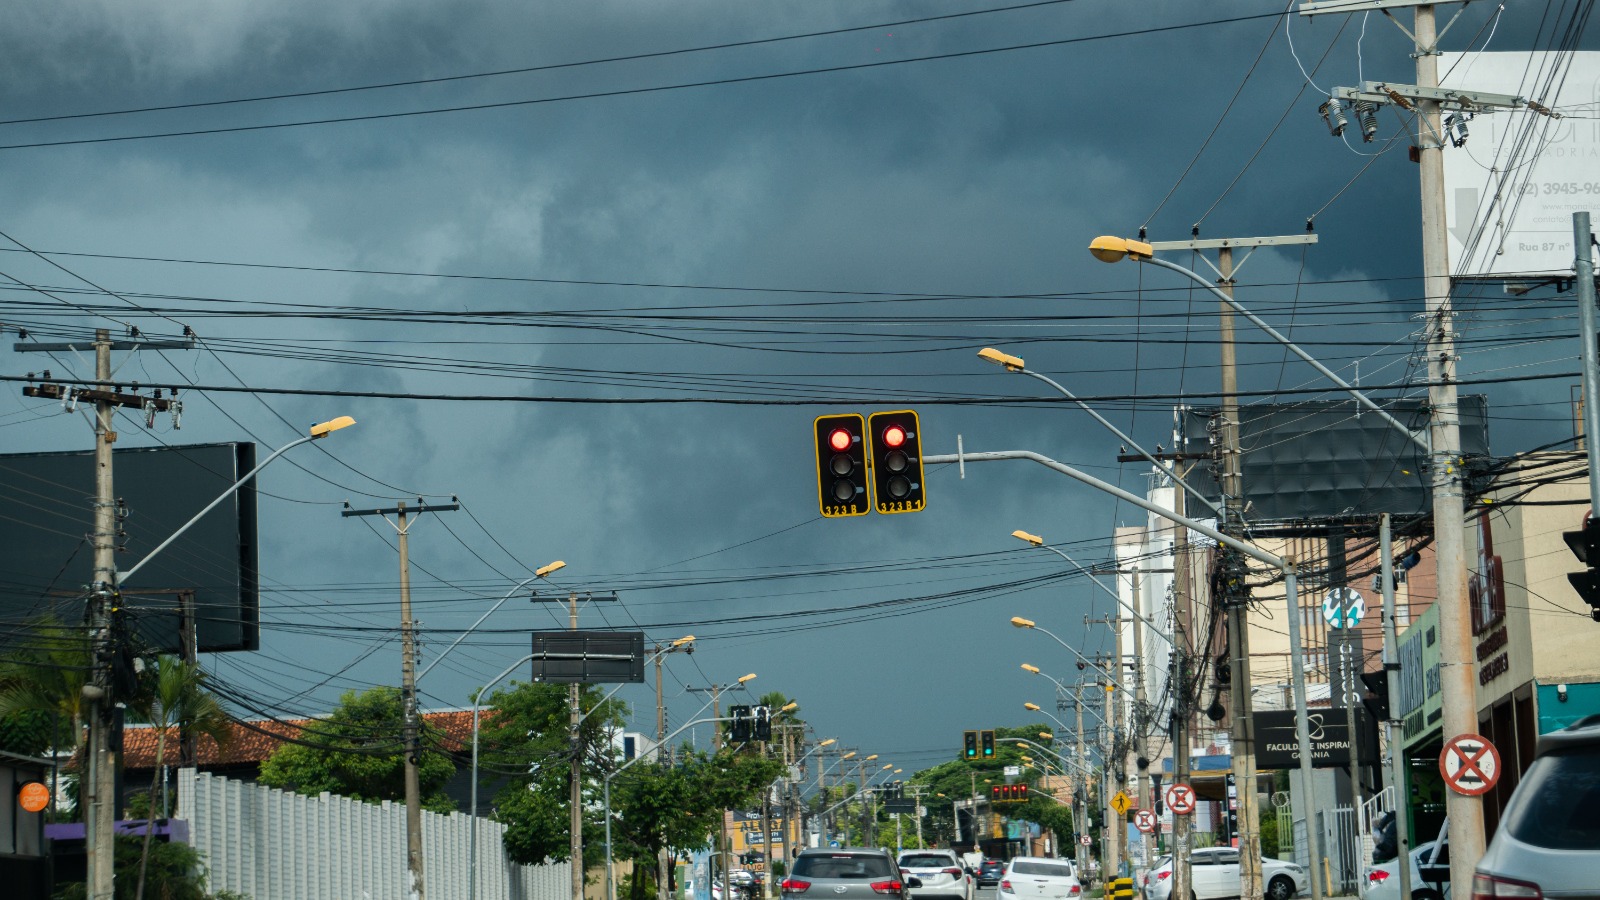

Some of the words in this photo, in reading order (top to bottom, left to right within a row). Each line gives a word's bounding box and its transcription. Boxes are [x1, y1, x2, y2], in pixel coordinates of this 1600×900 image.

[1512, 182, 1538, 197] (62)
[1543, 182, 1600, 194] 3945-96
[1519, 243, 1539, 251] Rua
[1542, 243, 1555, 251] 87
[1266, 743, 1314, 751] FACULDE
[1291, 751, 1330, 759] GNIA
